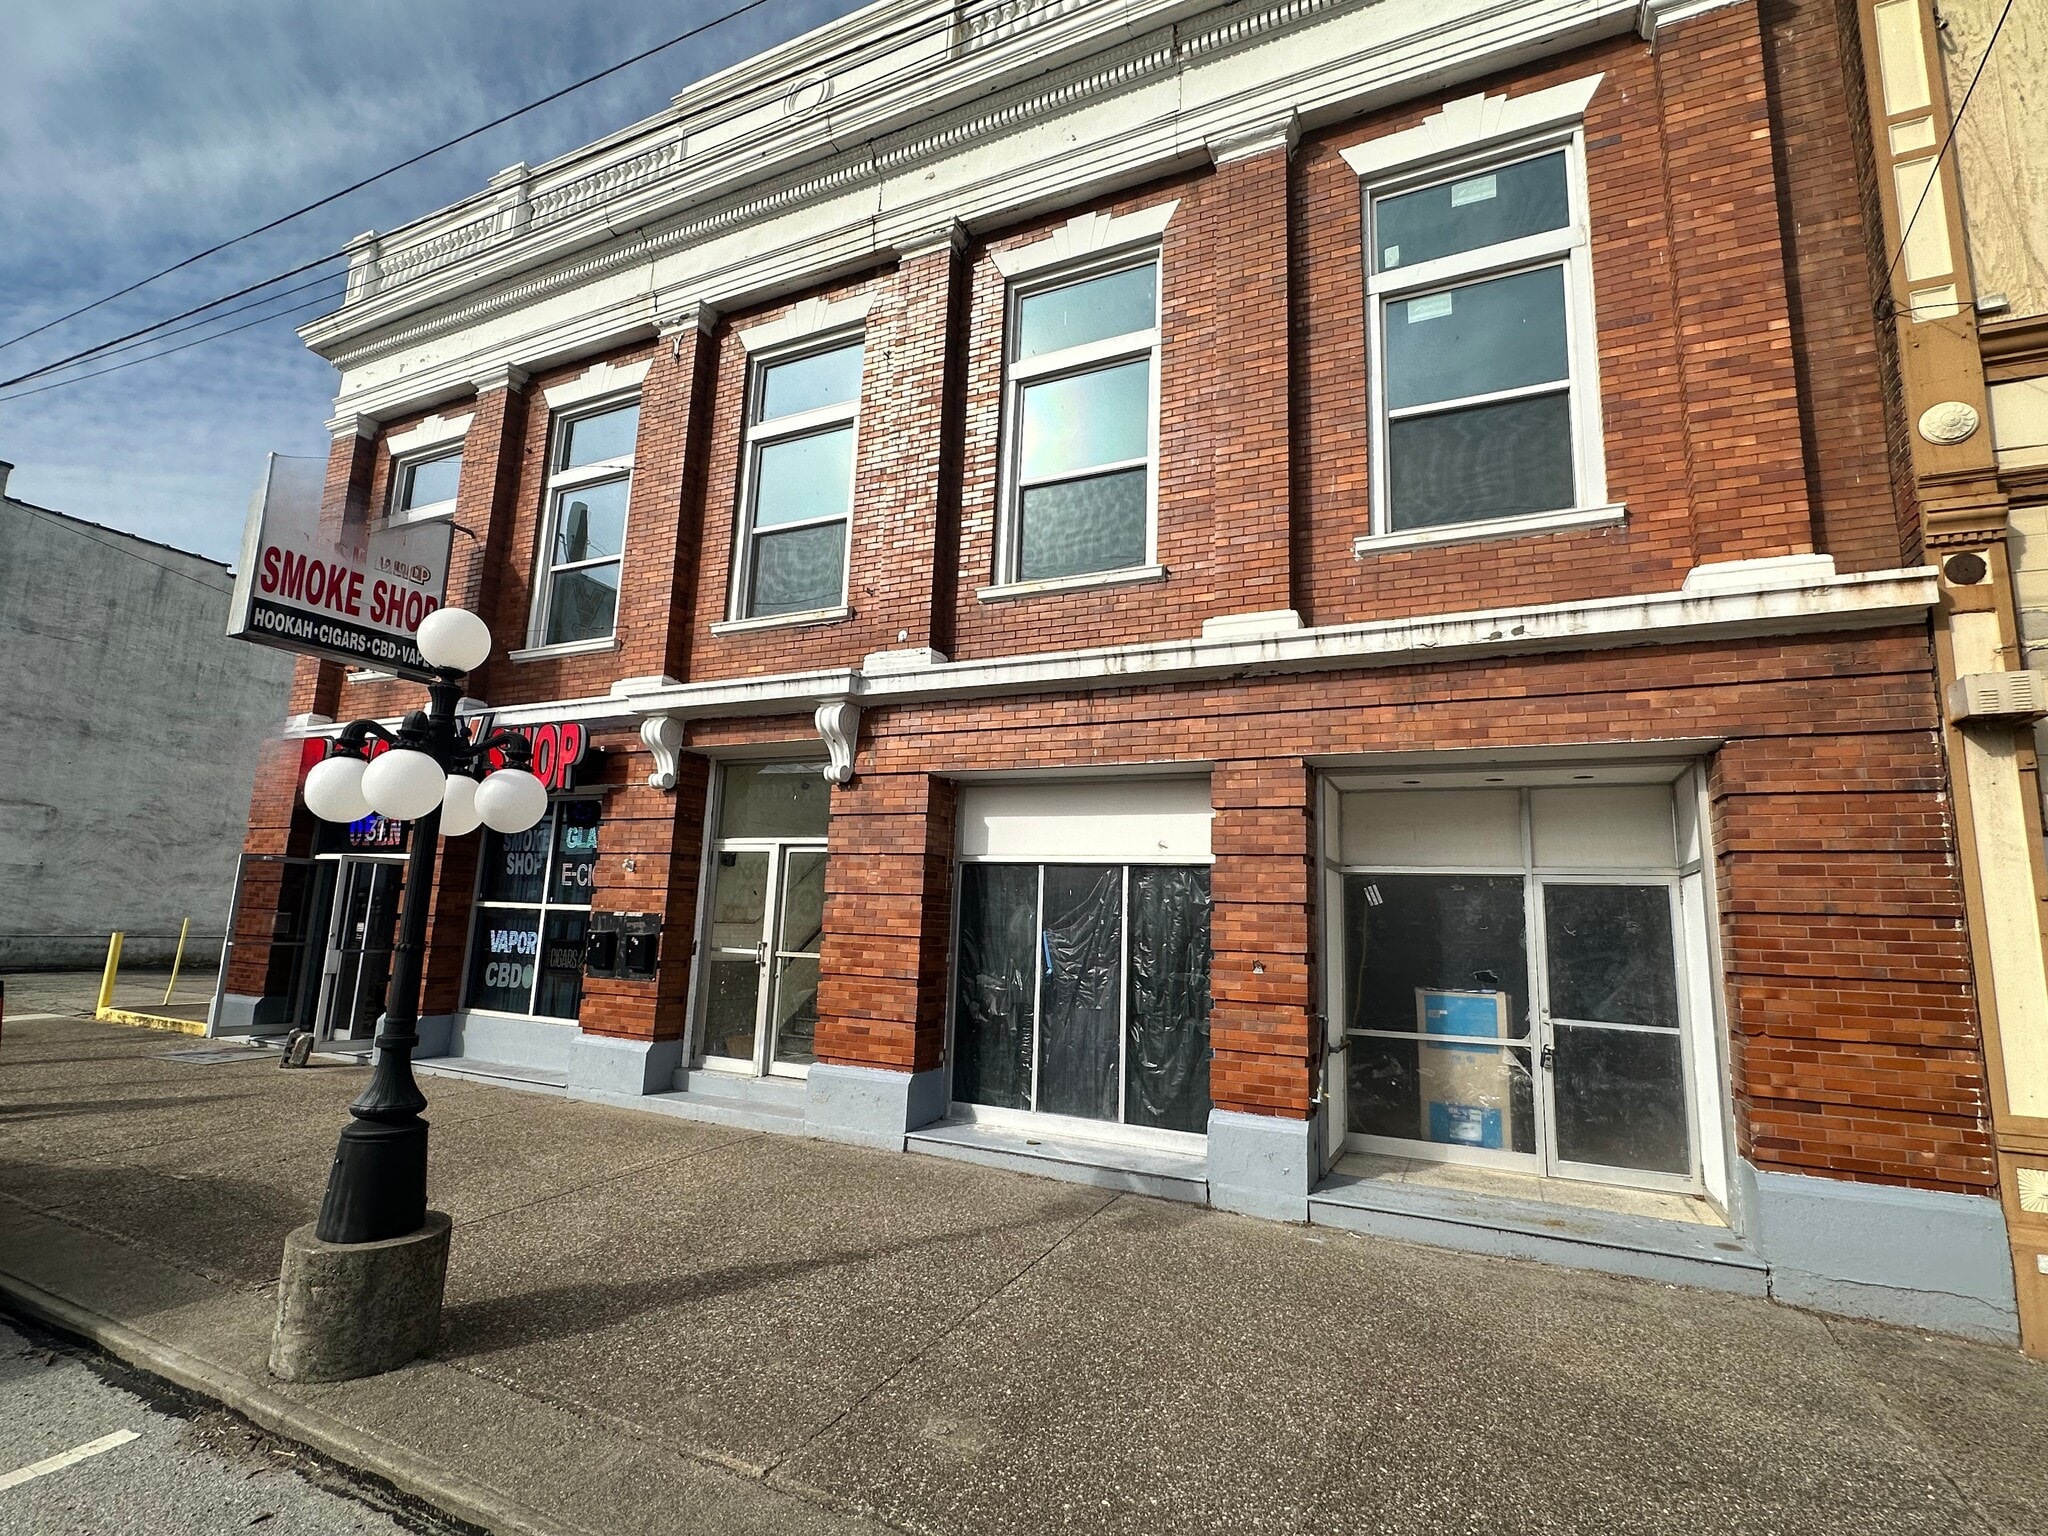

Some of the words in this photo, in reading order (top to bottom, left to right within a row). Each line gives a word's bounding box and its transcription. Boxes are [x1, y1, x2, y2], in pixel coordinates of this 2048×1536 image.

[260, 546, 365, 617] SMOKE
[254, 608, 314, 639] HOOKAH
[319, 624, 366, 652] CIGARS
[372, 638, 397, 660] CBD
[402, 645, 430, 668] VAP
[506, 852, 543, 875] SHOP
[490, 929, 538, 955] VAPOR
[550, 947, 578, 969] CIGARS
